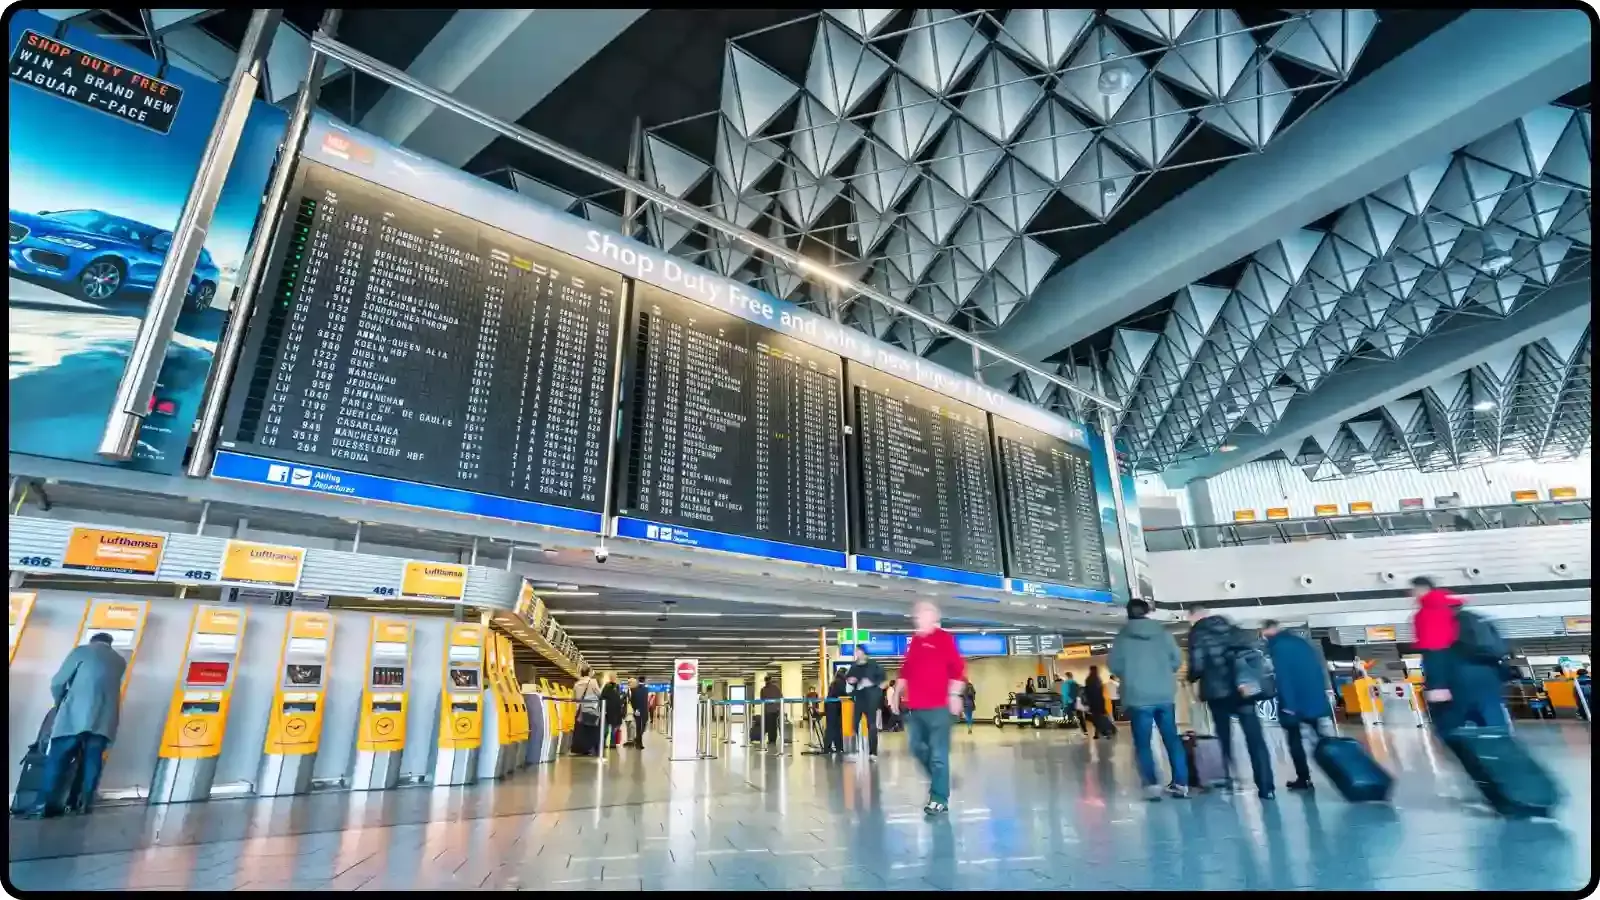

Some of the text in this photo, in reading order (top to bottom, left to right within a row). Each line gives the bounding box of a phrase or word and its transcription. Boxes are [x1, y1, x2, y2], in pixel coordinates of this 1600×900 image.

[27, 34, 169, 96] SHOP DUTY FREE
[19, 49, 173, 113] WIN A BRAND NEW
[11, 66, 148, 122] JAGUAR F-PACE
[586, 230, 654, 278] Shop
[664, 262, 722, 296] Duty
[728, 283, 774, 319] Free
[780, 310, 817, 337] and
[340, 397, 372, 410] PARIS
[336, 417, 400, 435] CASABLANCA
[333, 427, 397, 445] MANCHESTER
[331, 438, 400, 457] DUESSELDORF
[330, 448, 369, 462] VERONA
[314, 471, 341, 484] Abflug
[312, 480, 356, 493] Departures
[100, 535, 158, 549] Lufthansa
[19, 556, 51, 567] 466
[250, 549, 298, 561] Lufthansa
[184, 570, 212, 580] 465
[372, 586, 394, 596] 464
